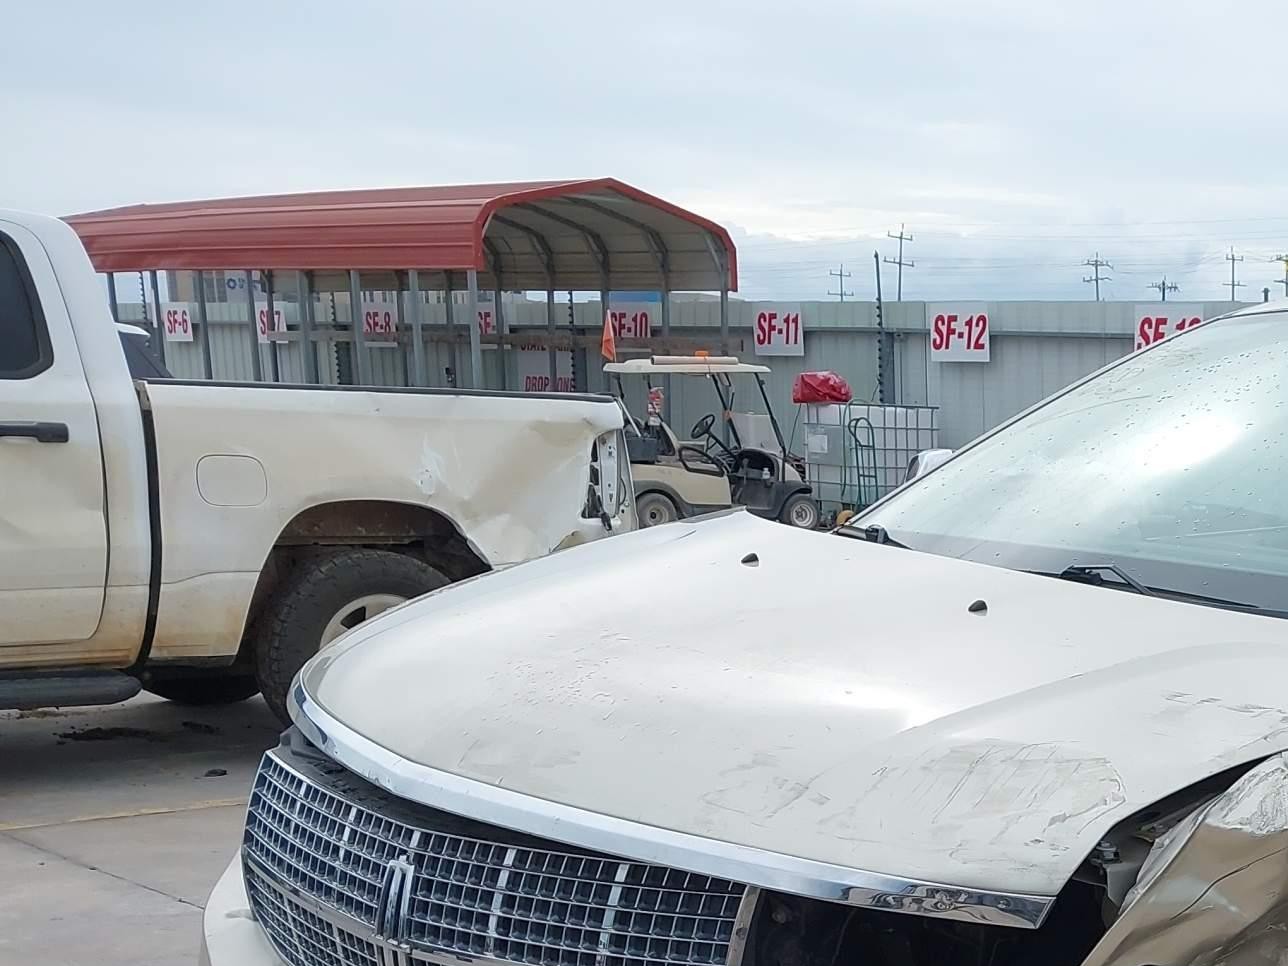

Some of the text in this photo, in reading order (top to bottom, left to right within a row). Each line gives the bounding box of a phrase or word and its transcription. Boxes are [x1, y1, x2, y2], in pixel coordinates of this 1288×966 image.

[166, 309, 189, 335] SF-6
[365, 311, 391, 334] SF-8
[611, 311, 649, 338] SF-10
[756, 311, 800, 346] SF-11
[932, 313, 988, 351] SF-12
[525, 375, 550, 392] DROP
